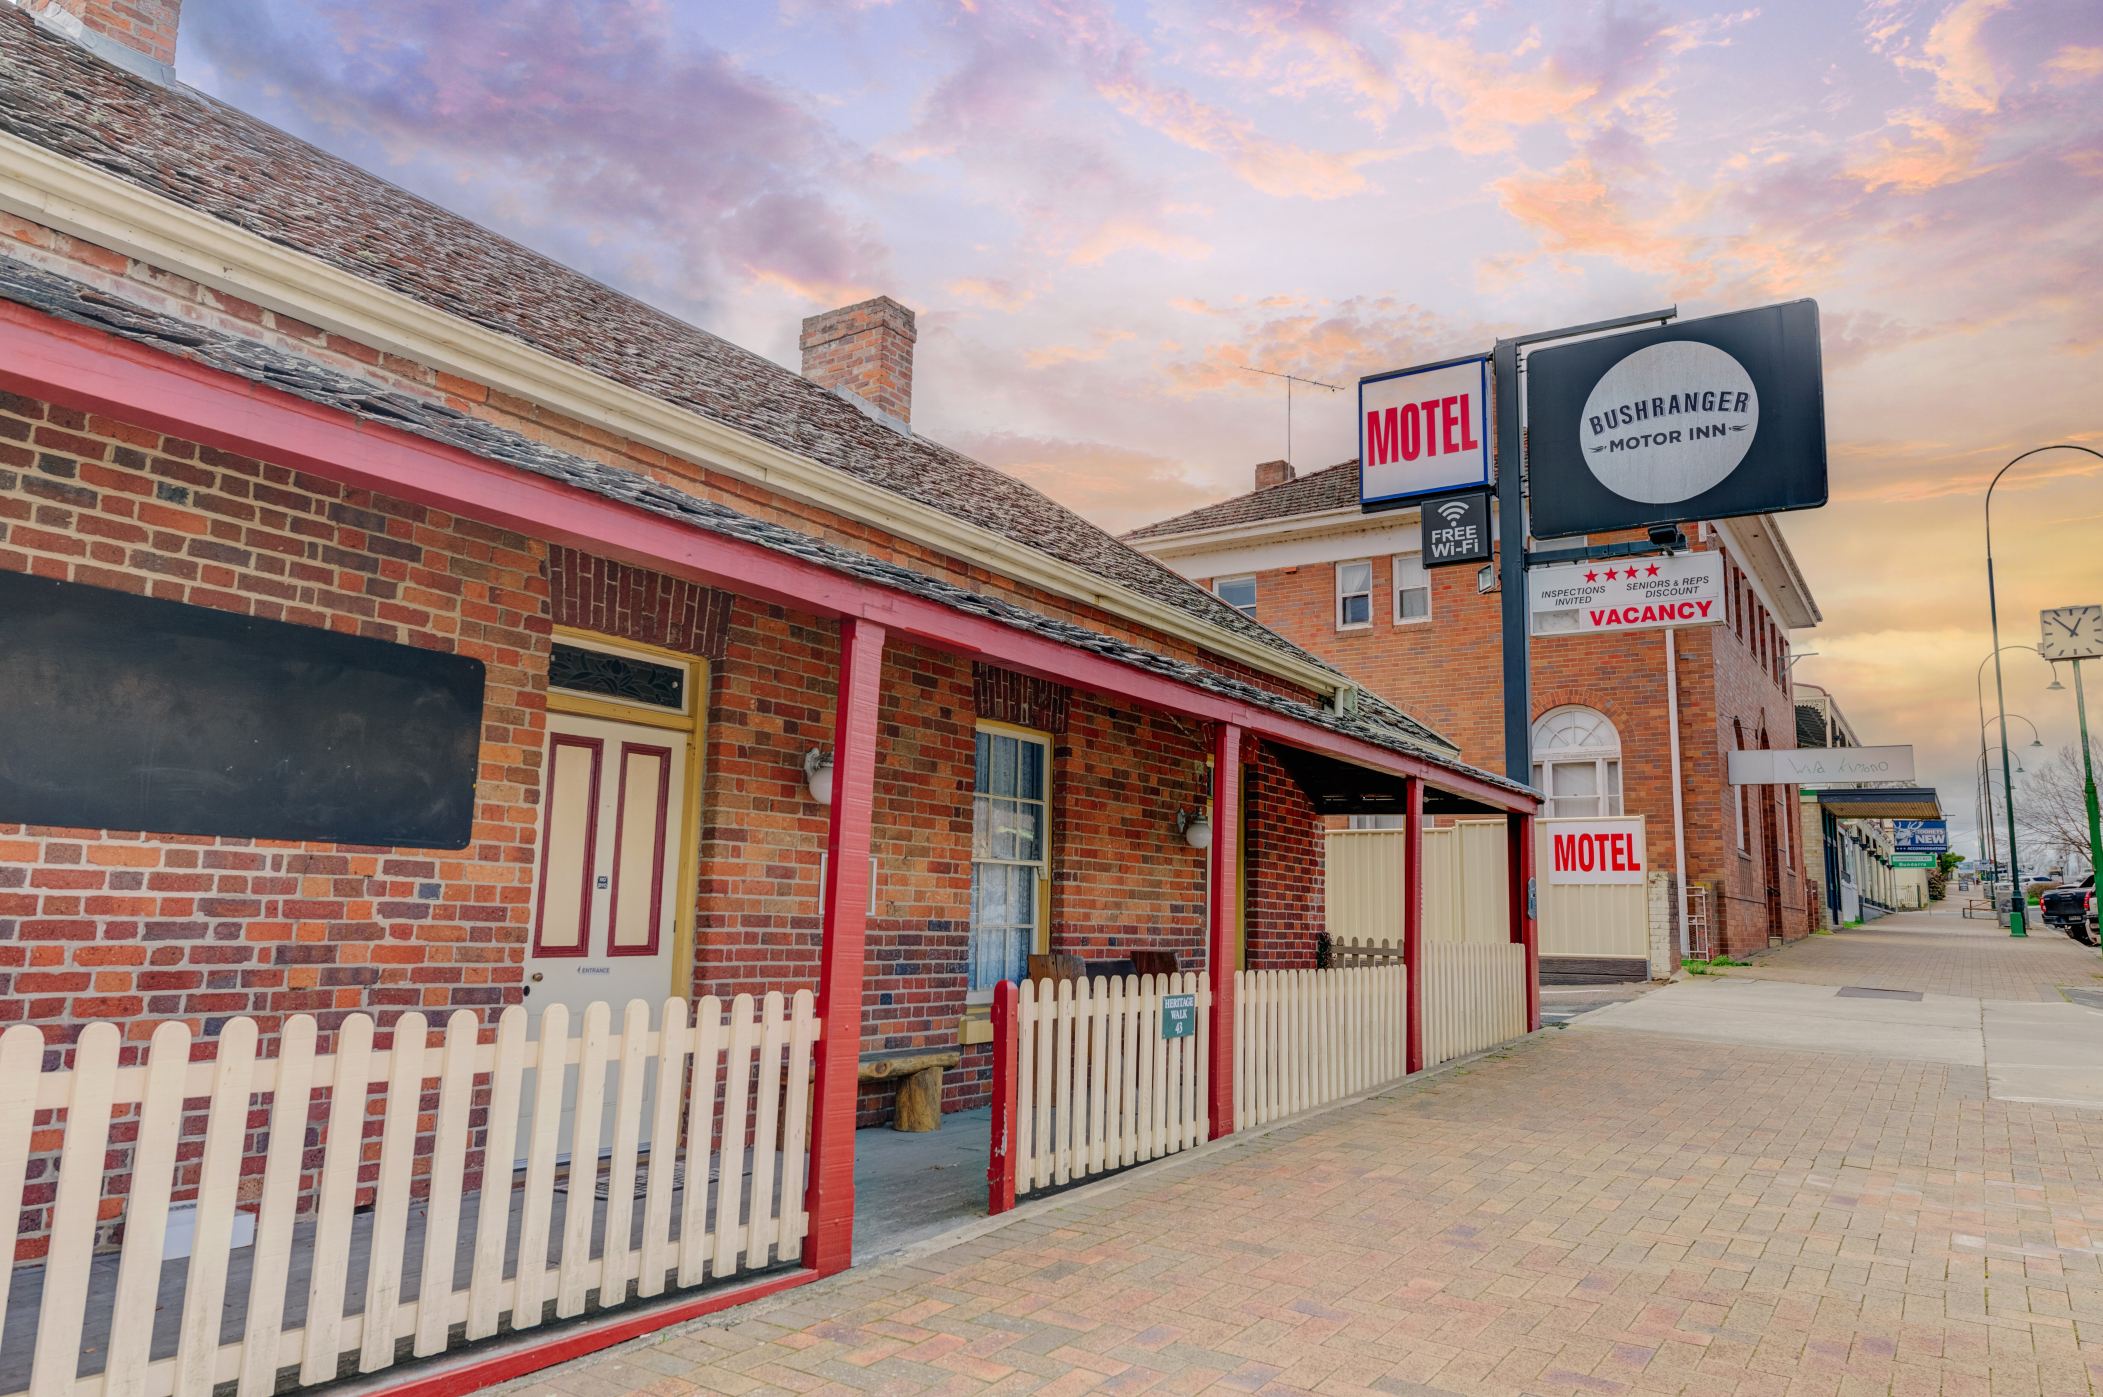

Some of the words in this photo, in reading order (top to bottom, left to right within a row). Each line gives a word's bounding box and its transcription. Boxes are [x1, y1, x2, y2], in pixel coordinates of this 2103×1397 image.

[1588, 390, 1750, 436] BUSHRANGER
[1367, 393, 1478, 467] MOTEL
[1609, 430, 1682, 453] MOTOR
[1689, 423, 1726, 441] INN
[1431, 525, 1477, 544] FREE
[1431, 538, 1479, 558] Wi-Fi
[1626, 578, 1670, 591] SENIORS
[1673, 579, 1680, 587] &
[1682, 575, 1710, 586] REPS
[1541, 585, 1606, 599] INSPECTIONS
[1645, 586, 1700, 599] DISCOUNT
[1555, 595, 1592, 607] INVITED
[1589, 600, 1713, 627] VACANCY
[1915, 834, 1946, 844] NEW
[1554, 833, 1640, 872] MOTEL
[1164, 996, 1194, 1009] HERITAGE
[1170, 1009, 1188, 1020] WALK
[1175, 1021, 1183, 1035] 43
